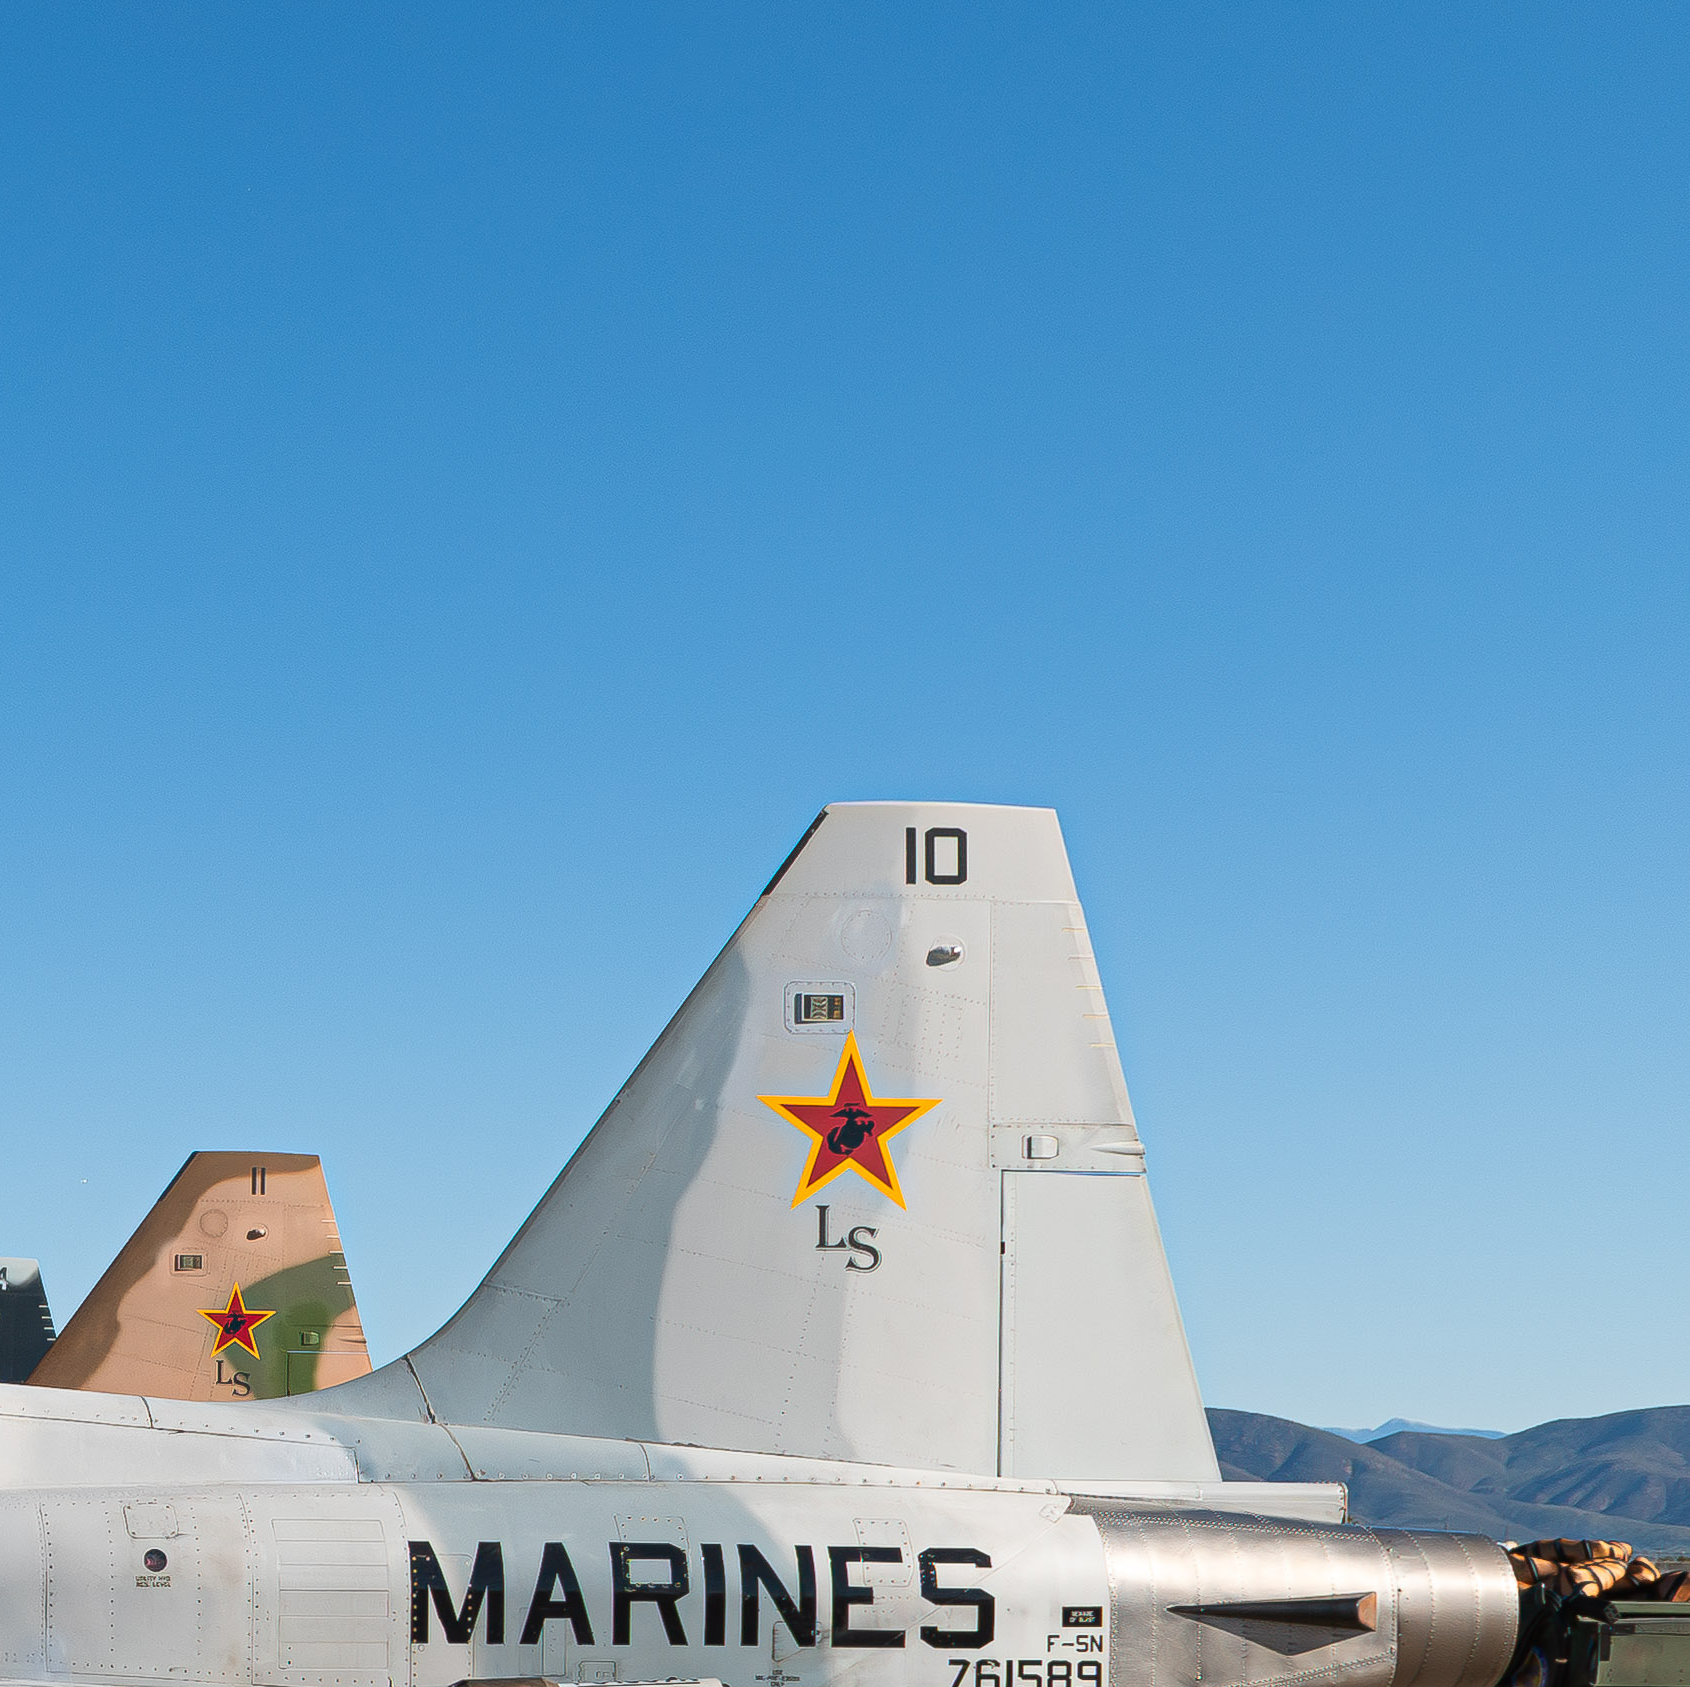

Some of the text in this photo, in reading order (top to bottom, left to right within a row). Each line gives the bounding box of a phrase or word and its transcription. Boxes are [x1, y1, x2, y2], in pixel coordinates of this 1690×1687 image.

[905, 827, 968, 885] 10
[815, 1205, 883, 1273] LS
[216, 1360, 251, 1396] LS
[408, 1540, 996, 1650] MARINES
